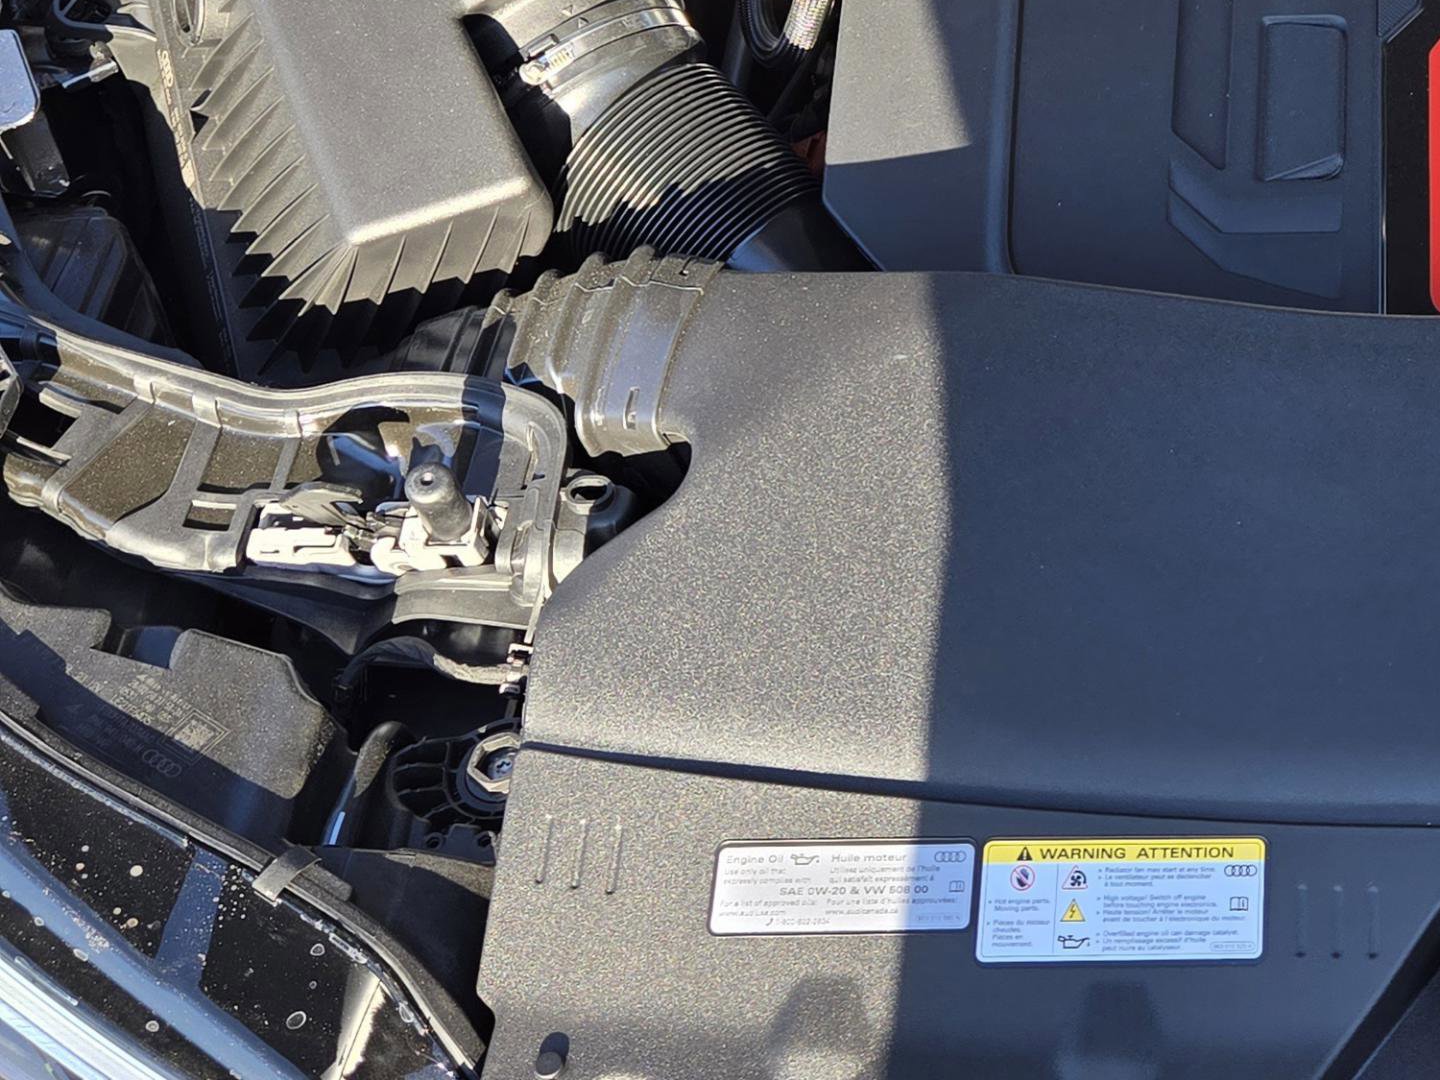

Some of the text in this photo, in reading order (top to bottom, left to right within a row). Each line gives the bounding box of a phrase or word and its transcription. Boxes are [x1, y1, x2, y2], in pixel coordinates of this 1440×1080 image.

[831, 854, 907, 862] Huile moteur
[1039, 848, 1235, 859] WARNING ATTENTION
[727, 855, 764, 864] Engine
[779, 885, 929, 896] SAE 0W-20 & VW 508 00
